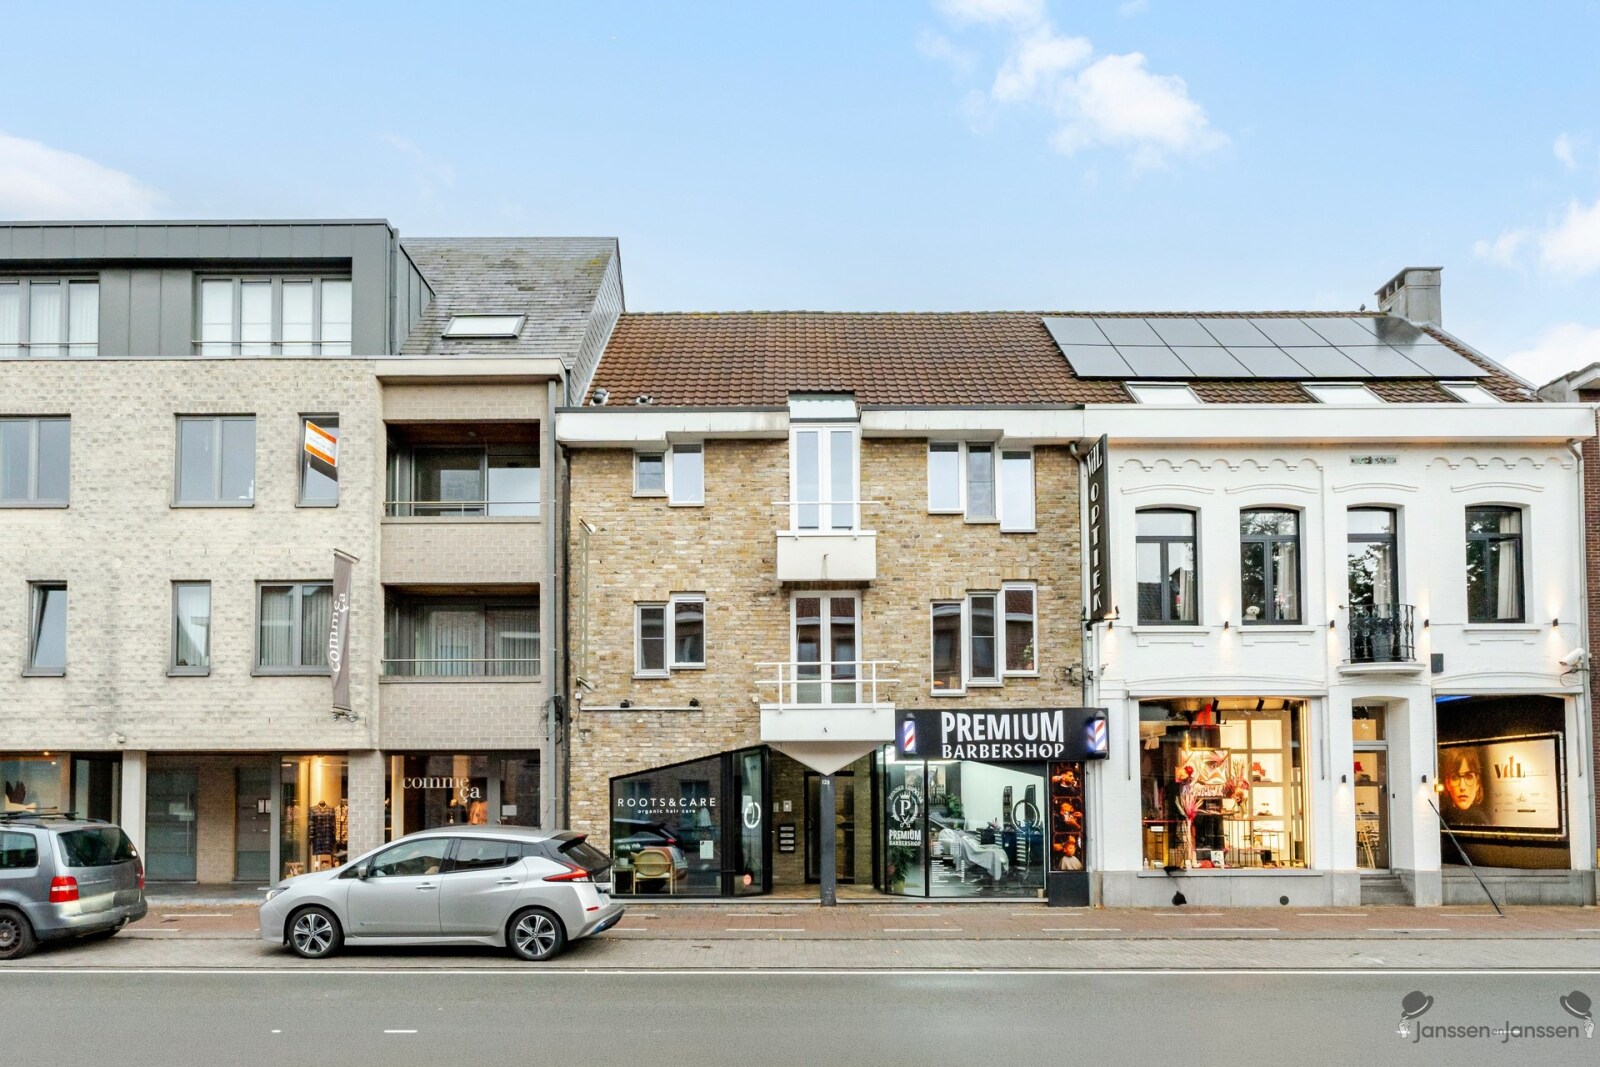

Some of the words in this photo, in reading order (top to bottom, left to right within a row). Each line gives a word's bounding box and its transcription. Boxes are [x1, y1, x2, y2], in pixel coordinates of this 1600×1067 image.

[1091, 482, 1102, 612] OPTIEK
[338, 593, 349, 613] ça
[329, 600, 341, 672] comme
[941, 710, 1065, 743] PREMIUM
[942, 743, 1065, 759] BARBERSHOP
[402, 776, 470, 789] comme
[459, 786, 482, 803] ça
[617, 797, 717, 807] ROOTS&CARE
[888, 829, 922, 841] PREMIUM
